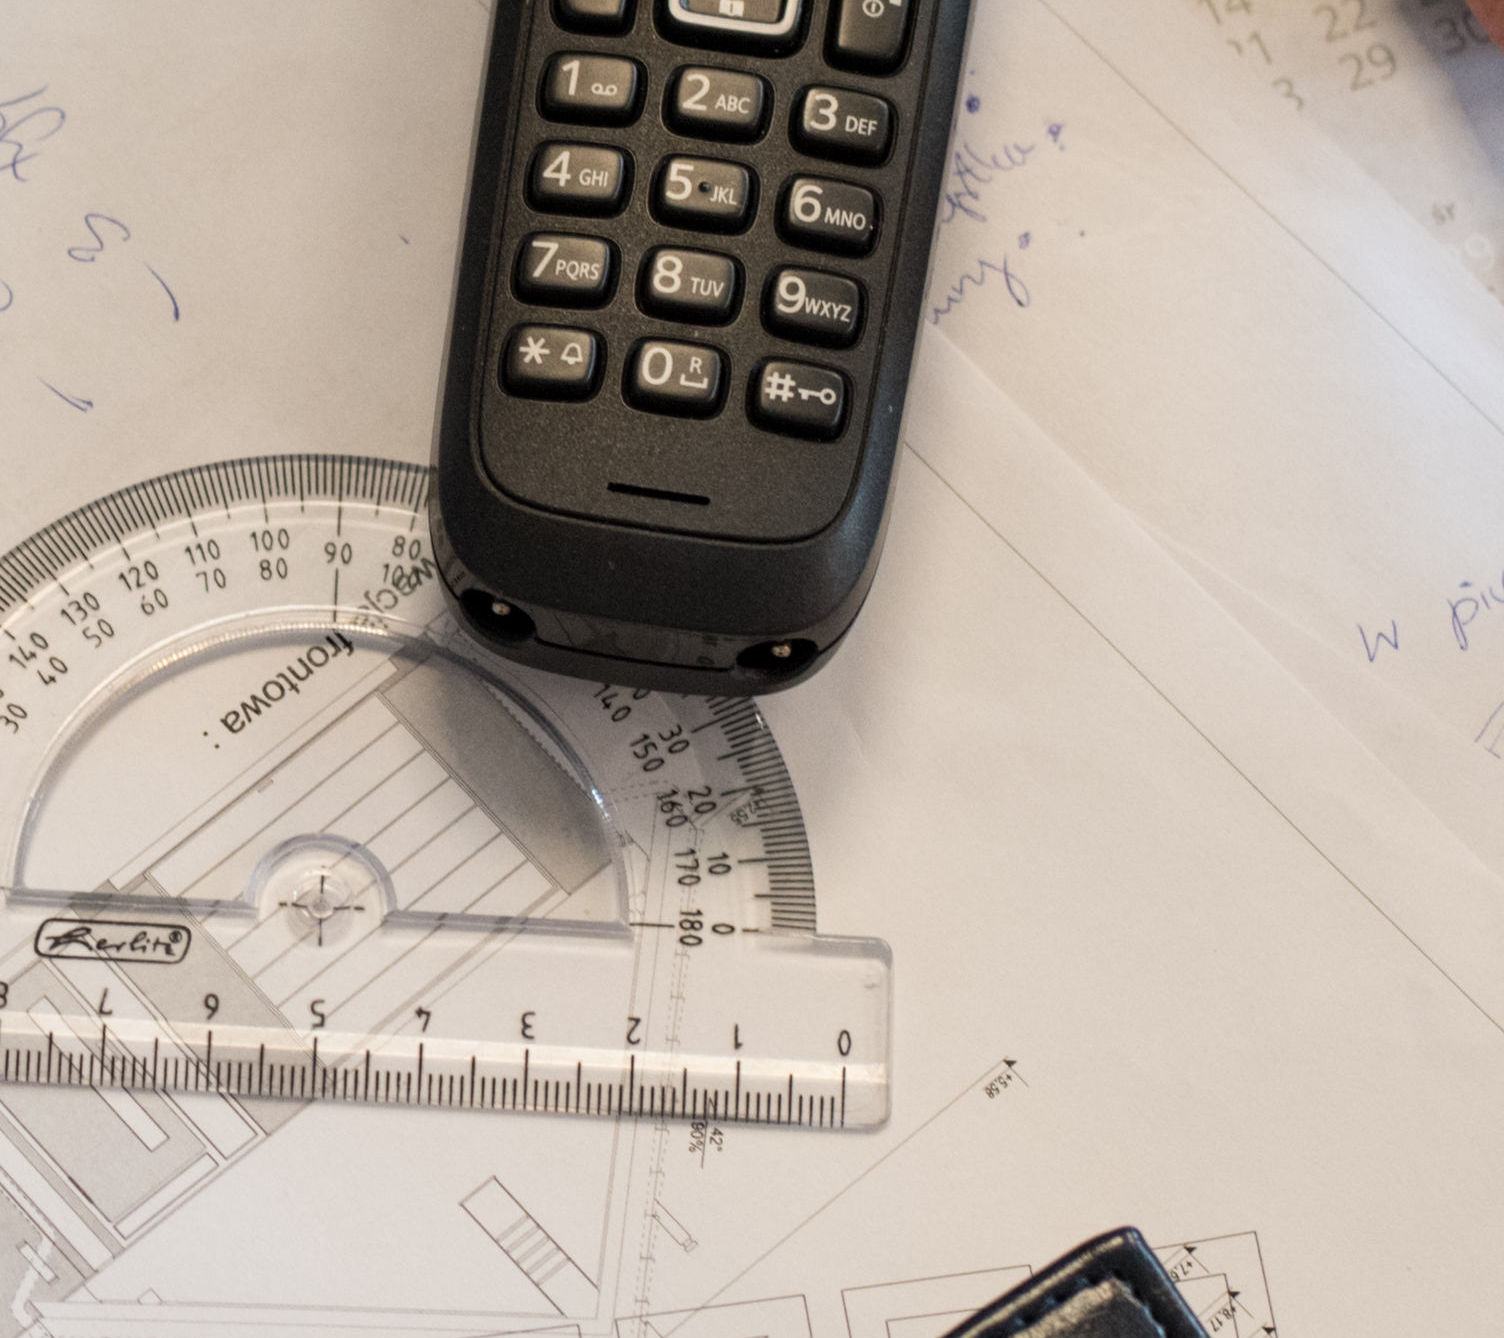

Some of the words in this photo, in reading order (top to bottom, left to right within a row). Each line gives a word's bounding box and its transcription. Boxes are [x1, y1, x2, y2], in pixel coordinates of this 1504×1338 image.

[561, 60, 581, 96] 1
[682, 74, 711, 111] 2
[714, 93, 751, 115] ABC
[810, 94, 838, 131] 3
[845, 116, 878, 137] DEF
[542, 151, 572, 187] 4
[578, 168, 609, 188] GHI
[665, 163, 695, 200] 5
[709, 185, 738, 206] JKL
[793, 185, 823, 222] 6
[824, 209, 866, 231] MNO
[531, 241, 559, 278] 7
[555, 261, 601, 281] PQRS
[652, 255, 683, 294] 8
[690, 276, 725, 298] TUV
[776, 275, 806, 313] 9
[804, 298, 854, 323] WXYZ
[641, 347, 673, 386] 0
[184, 537, 222, 567] 110
[249, 527, 290, 553] 100
[324, 541, 353, 566] 90
[118, 559, 161, 592] 120
[60, 590, 101, 626] 130
[9, 630, 51, 669] 140
[218, 628, 355, 738] frontowa
[672, 847, 701, 887] 170
[678, 908, 703, 948] 180
